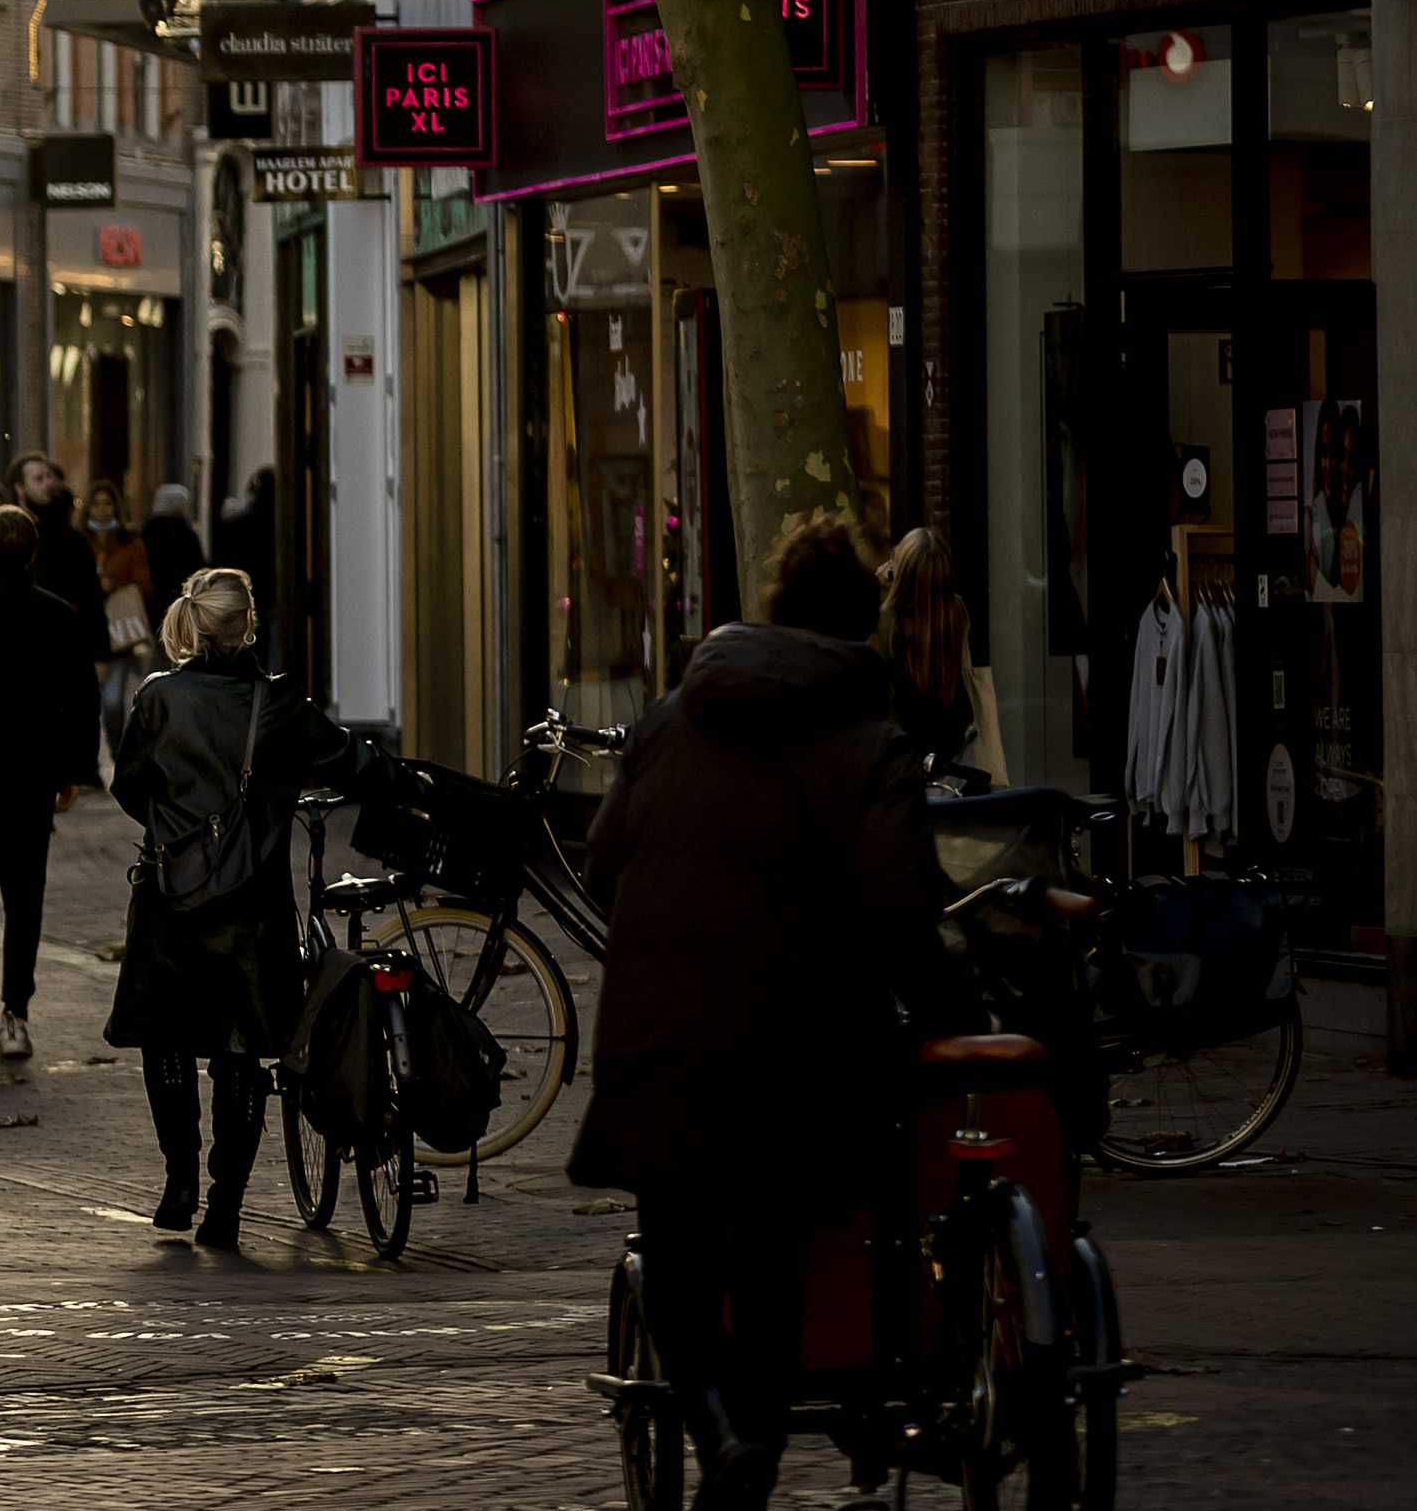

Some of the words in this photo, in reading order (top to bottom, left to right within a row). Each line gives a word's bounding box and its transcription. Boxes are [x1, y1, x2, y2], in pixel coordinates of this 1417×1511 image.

[406, 62, 448, 84] ICI
[385, 87, 469, 108] PARIS
[410, 111, 446, 133] XL
[318, 154, 354, 169] APAR
[46, 182, 112, 200] NELSON
[267, 170, 354, 193] HOTEL
